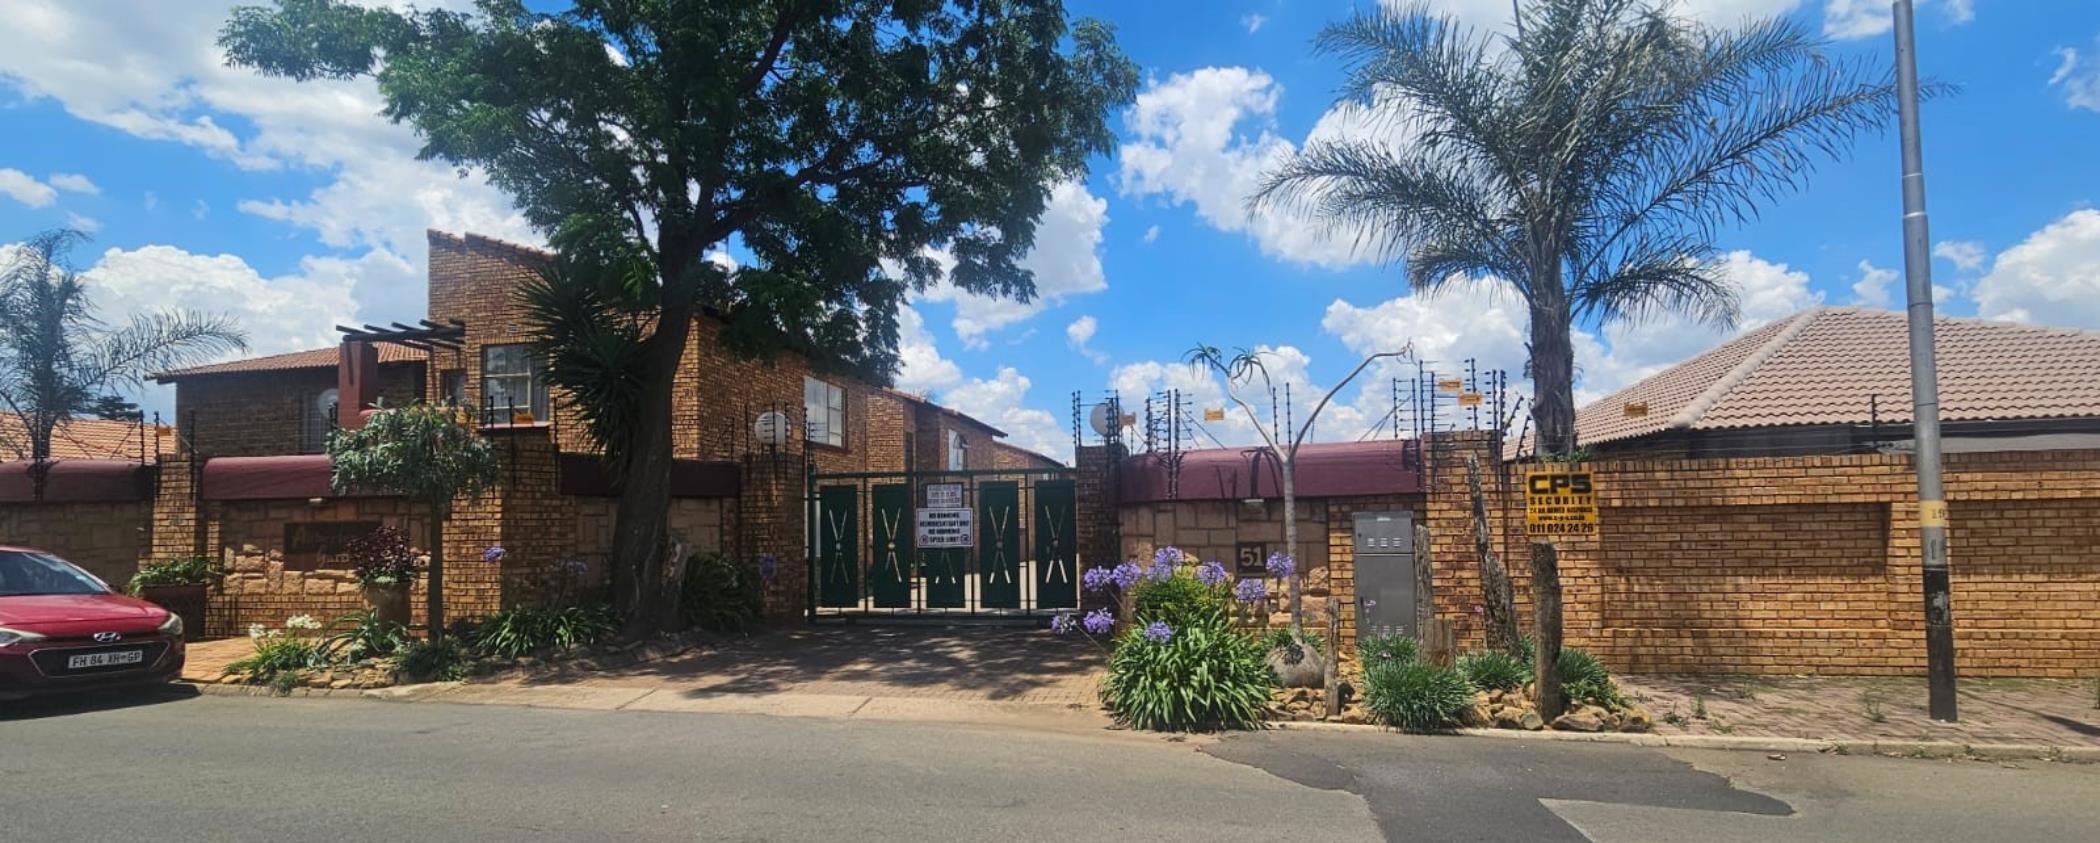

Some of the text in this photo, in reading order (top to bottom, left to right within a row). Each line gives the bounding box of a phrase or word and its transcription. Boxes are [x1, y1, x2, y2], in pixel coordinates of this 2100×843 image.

[1529, 474, 1592, 494] CPS
[1529, 496, 1591, 505] SECURITY
[1240, 546, 1265, 567] 51
